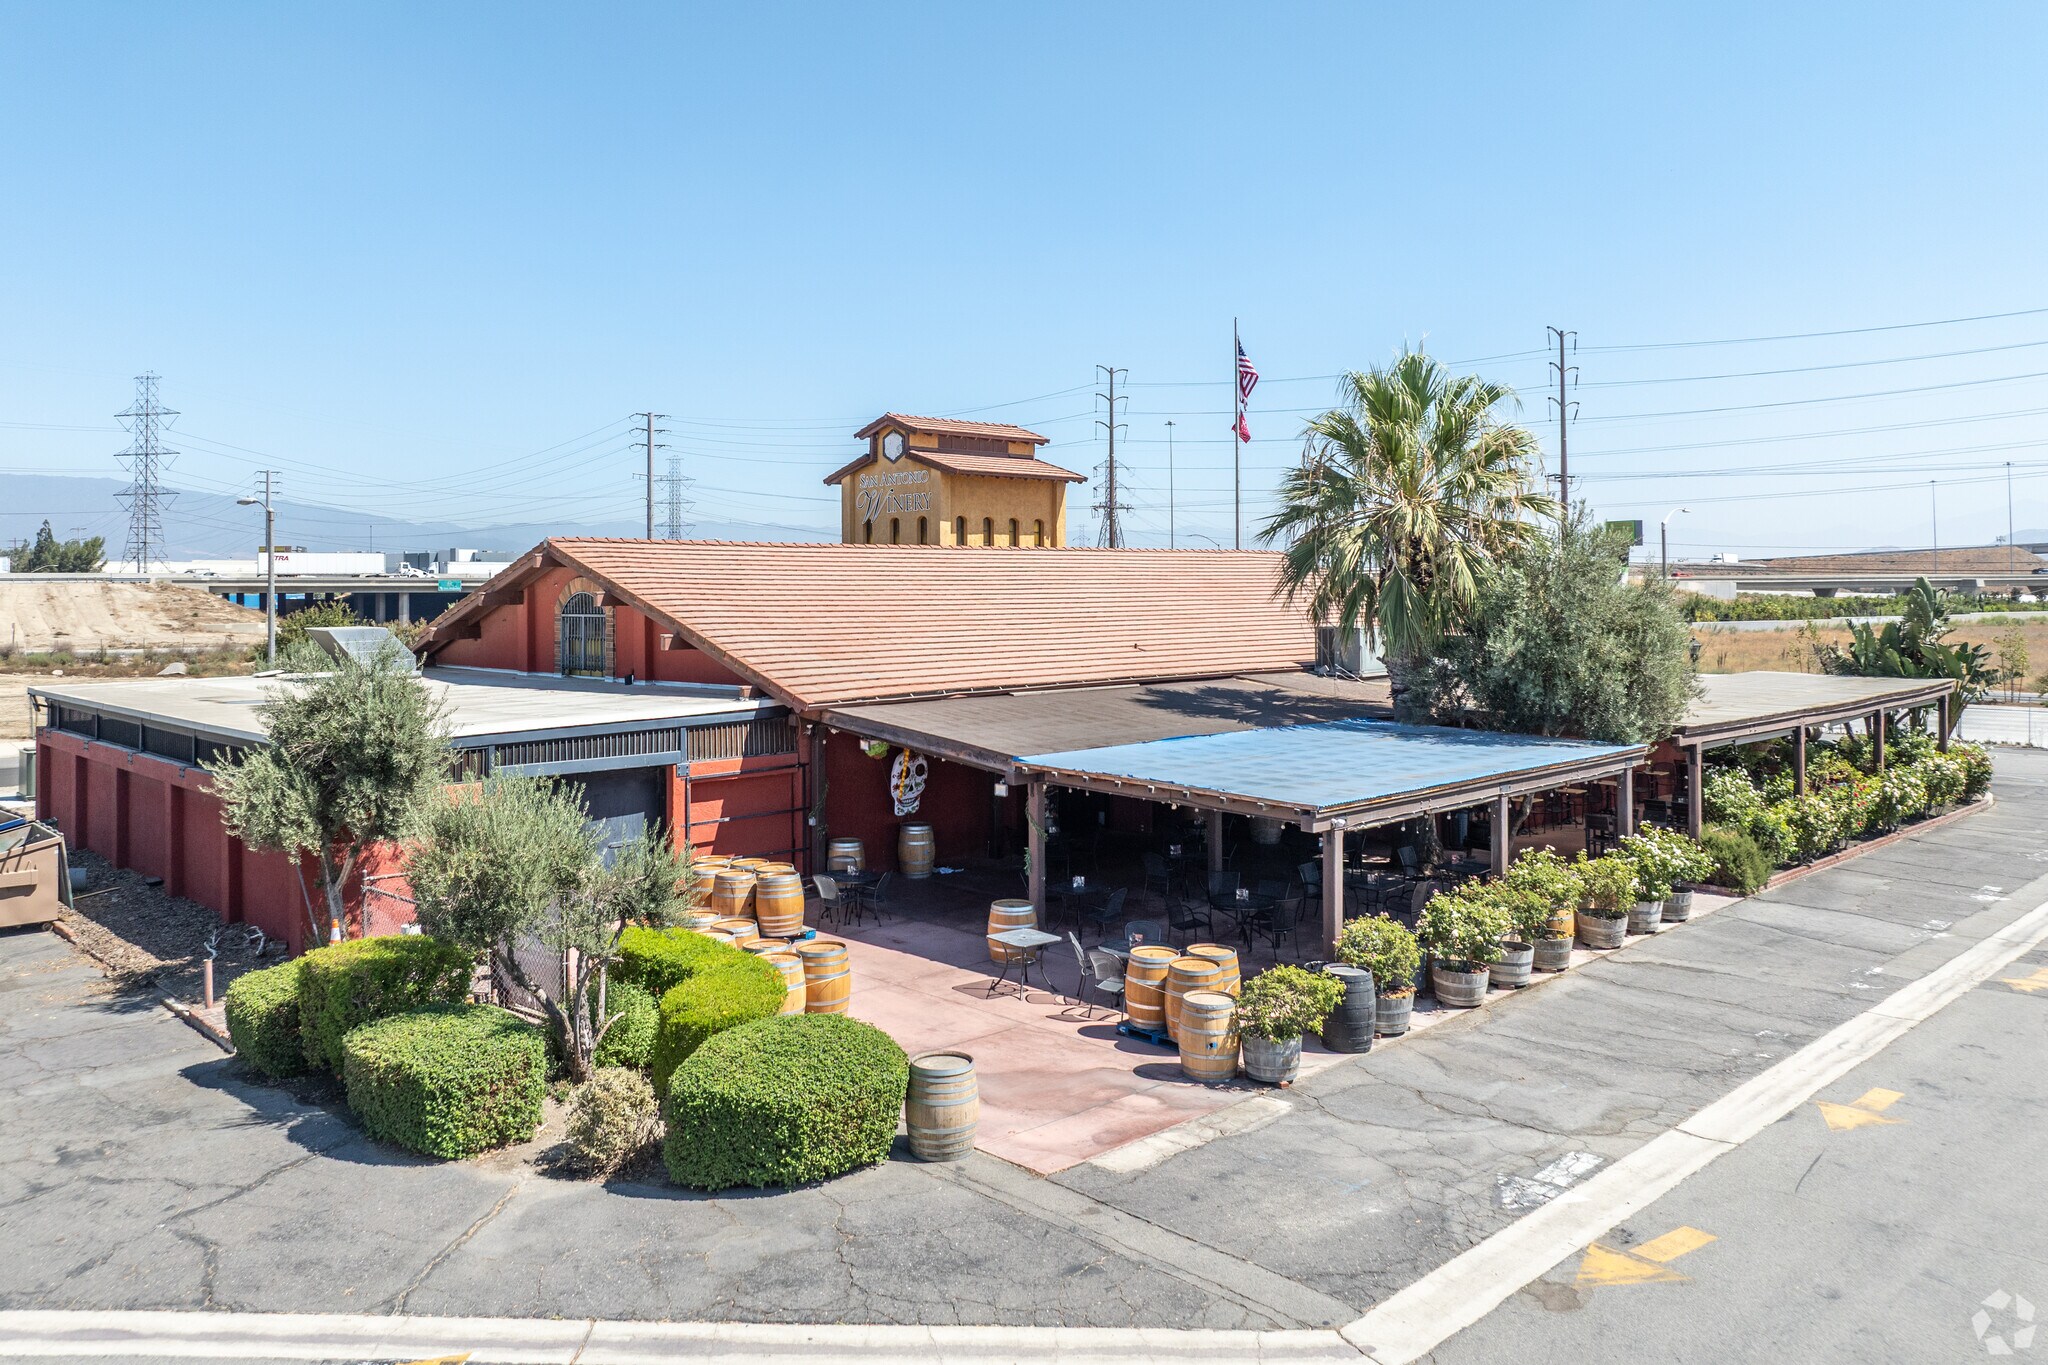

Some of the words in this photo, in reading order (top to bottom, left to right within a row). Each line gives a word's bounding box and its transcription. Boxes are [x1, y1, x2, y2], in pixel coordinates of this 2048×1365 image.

[859, 473, 878, 488] SAN
[879, 470, 929, 487] ANTONIO
[856, 488, 932, 524] WINERY
